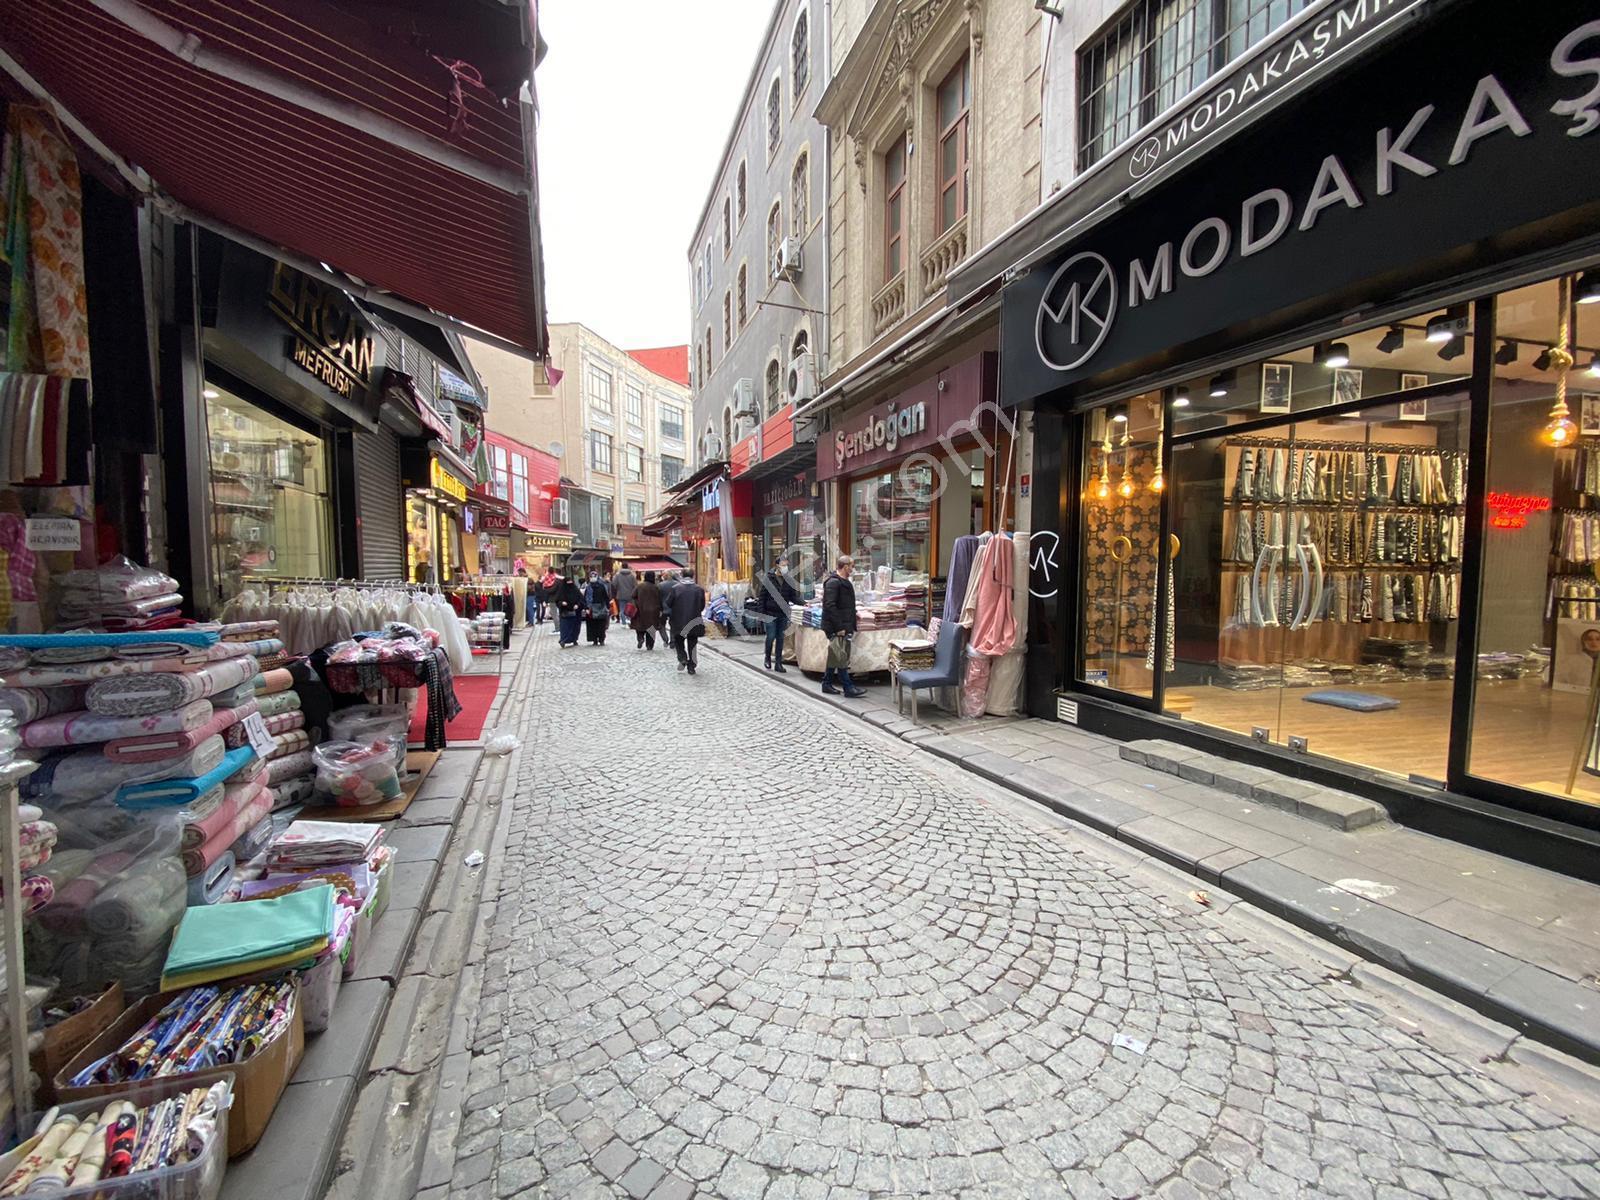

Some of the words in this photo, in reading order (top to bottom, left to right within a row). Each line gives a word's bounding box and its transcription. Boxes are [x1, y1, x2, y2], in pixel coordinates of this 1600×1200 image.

[1166, 0, 1398, 152] MODAKAŞM
[1127, 20, 1600, 308] MODAKAŞ
[835, 400, 926, 470] Şendoğan
